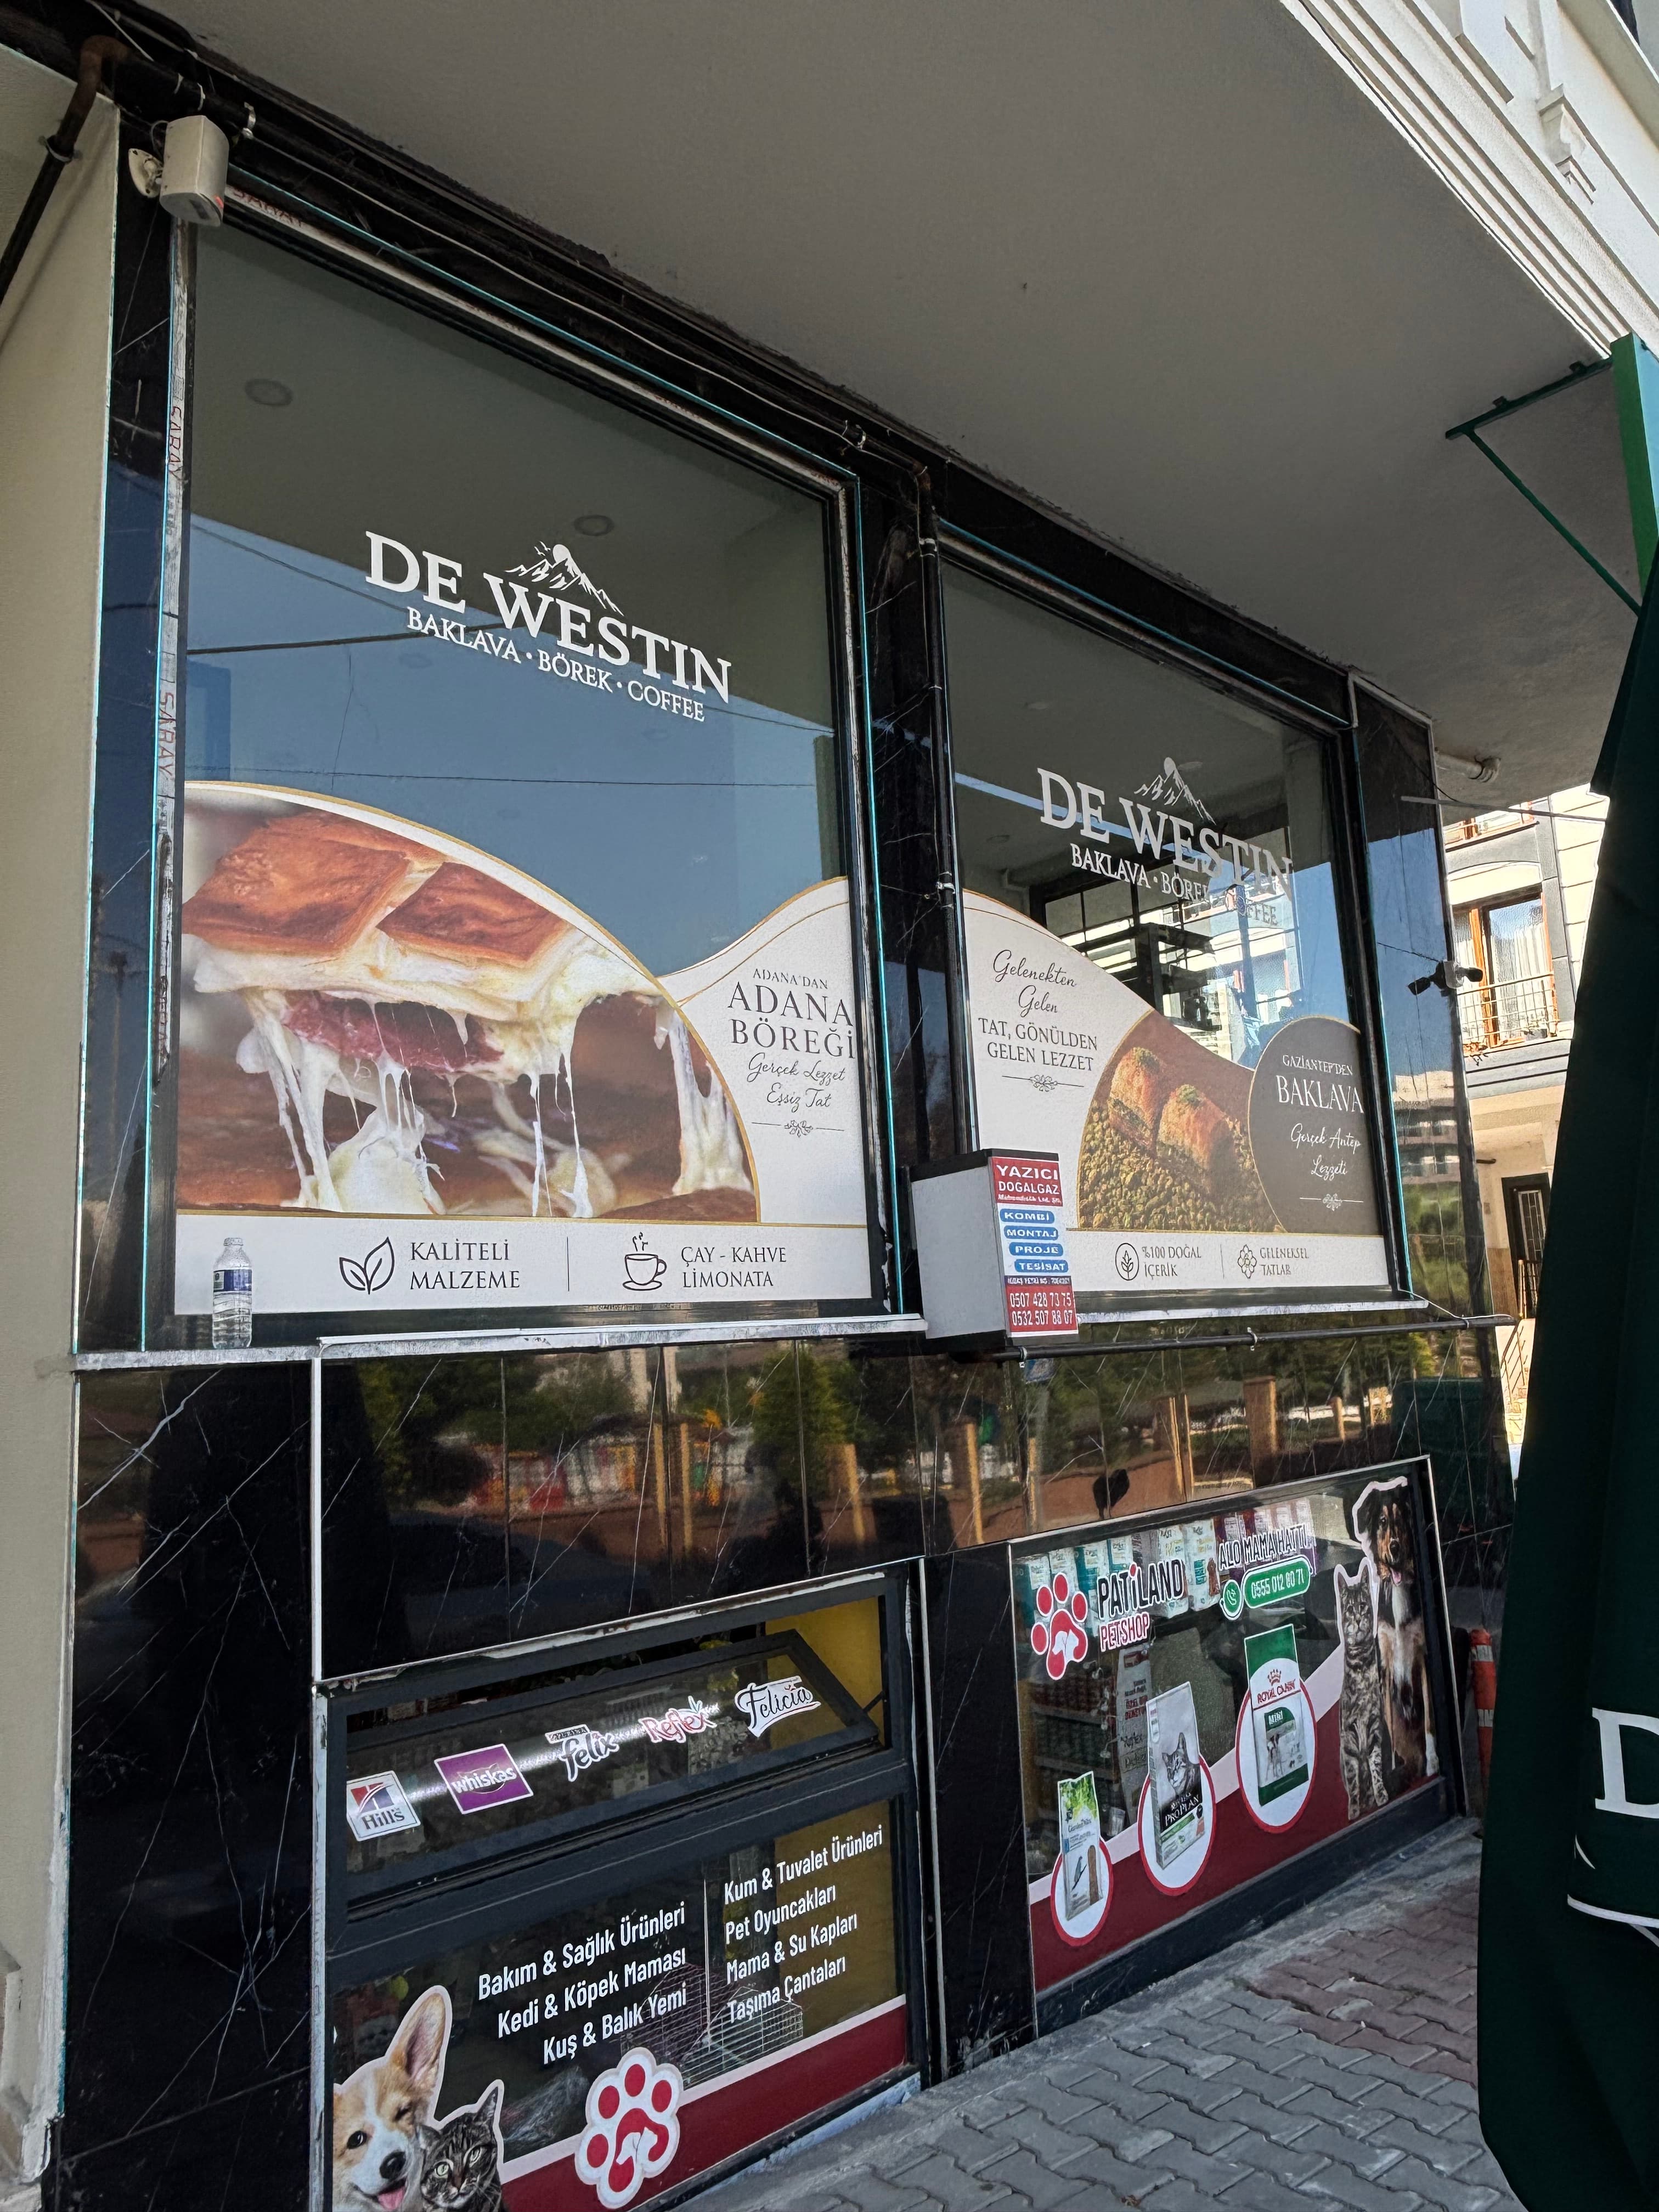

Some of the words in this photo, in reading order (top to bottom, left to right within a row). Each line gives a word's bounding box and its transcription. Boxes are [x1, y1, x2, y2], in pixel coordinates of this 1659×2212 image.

[365, 531, 466, 614] DE
[483, 572, 731, 704] WESTIN
[407, 606, 521, 664] BAKLAVA
[538, 649, 613, 693] BÖREK
[628, 680, 706, 722] COFFEE
[1037, 768, 1110, 844] DE
[1119, 797, 1294, 904] WESTIN
[1070, 843, 1151, 889] BAKLAVA
[753, 968, 828, 989] ADANA'DAN
[993, 950, 1077, 987] Gelenekten
[727, 981, 854, 1027] ADANA
[1018, 985, 1058, 1018] Gelen
[729, 1017, 856, 1059] BÖREĞİ
[978, 1017, 1011, 1040] TAT,
[1015, 1022, 1098, 1051] GÖNÜLDEN
[747, 1052, 799, 1083] Gerçek
[803, 1060, 846, 1086] Lezzet
[987, 1042, 1036, 1063] GELEN
[1041, 1049, 1094, 1071] LEZZET
[766, 1082, 801, 1113] Eşsiz
[805, 1088, 832, 1108] Tat
[1276, 1075, 1364, 1114] BAKLAVA
[1290, 1123, 1327, 1149] Gerçek
[1329, 1127, 1361, 1155] Antep
[996, 1164, 1058, 1180] YAZICI
[1311, 1154, 1347, 1181] Lezzeti
[410, 1238, 510, 1261] KALİTELİ
[1007, 1228, 1057, 1238] MONTAJ
[681, 1246, 715, 1267] ÇAY
[732, 1246, 787, 1263] KAHVE
[1015, 1246, 1059, 1255] PROJE
[1142, 1246, 1165, 1259] %100
[410, 1270, 521, 1290] MALZEME
[682, 1268, 774, 1288] LİMONATA
[1010, 1292, 1029, 1308] 0507
[1032, 1292, 1048, 1308] 428
[1049, 1292, 1060, 1307] 73
[1012, 1310, 1033, 1326] 0532
[1035, 1310, 1049, 1325] 507
[1218, 1540, 1242, 1571] ALO
[1243, 1532, 1277, 1564] MAMA
[1271, 1573, 1285, 1593] 012
[1099, 1612, 1149, 1652] PETSHOP
[737, 1684, 812, 1729] Felicia
[640, 1708, 716, 1743] Reflex
[561, 1732, 617, 1780] felix
[451, 1767, 517, 1794] whiskas
[361, 1807, 405, 1830] Hill's
[724, 1875, 757, 1906] Kum
[761, 1867, 773, 1891] &
[776, 1847, 828, 1886] Tuvalet
[831, 1824, 883, 1863] Ürünleri
[725, 1916, 750, 1945] Pet
[754, 1884, 837, 1934] Oyuncakları
[478, 1962, 537, 2001] Bakım
[542, 1949, 557, 1976] &
[562, 1928, 614, 1970] Sağlık
[620, 1900, 685, 1946] Ürünleri
[726, 1950, 771, 1985] Mama
[774, 1940, 786, 1963] &
[789, 1934, 807, 1957] Su
[810, 1913, 858, 1951] Kapları
[498, 2000, 539, 2039] Kedi
[544, 1993, 558, 2019] &
[564, 1971, 619, 2013] Köpek
[624, 1948, 686, 1989] Maması
[727, 1989, 781, 2024] Taşıma
[783, 1955, 847, 2002] Çantaları
[543, 2035, 577, 2065] Kuş
[583, 2022, 597, 2047] &
[602, 2005, 642, 2040] Balık
[647, 1982, 687, 2020] Yemi
